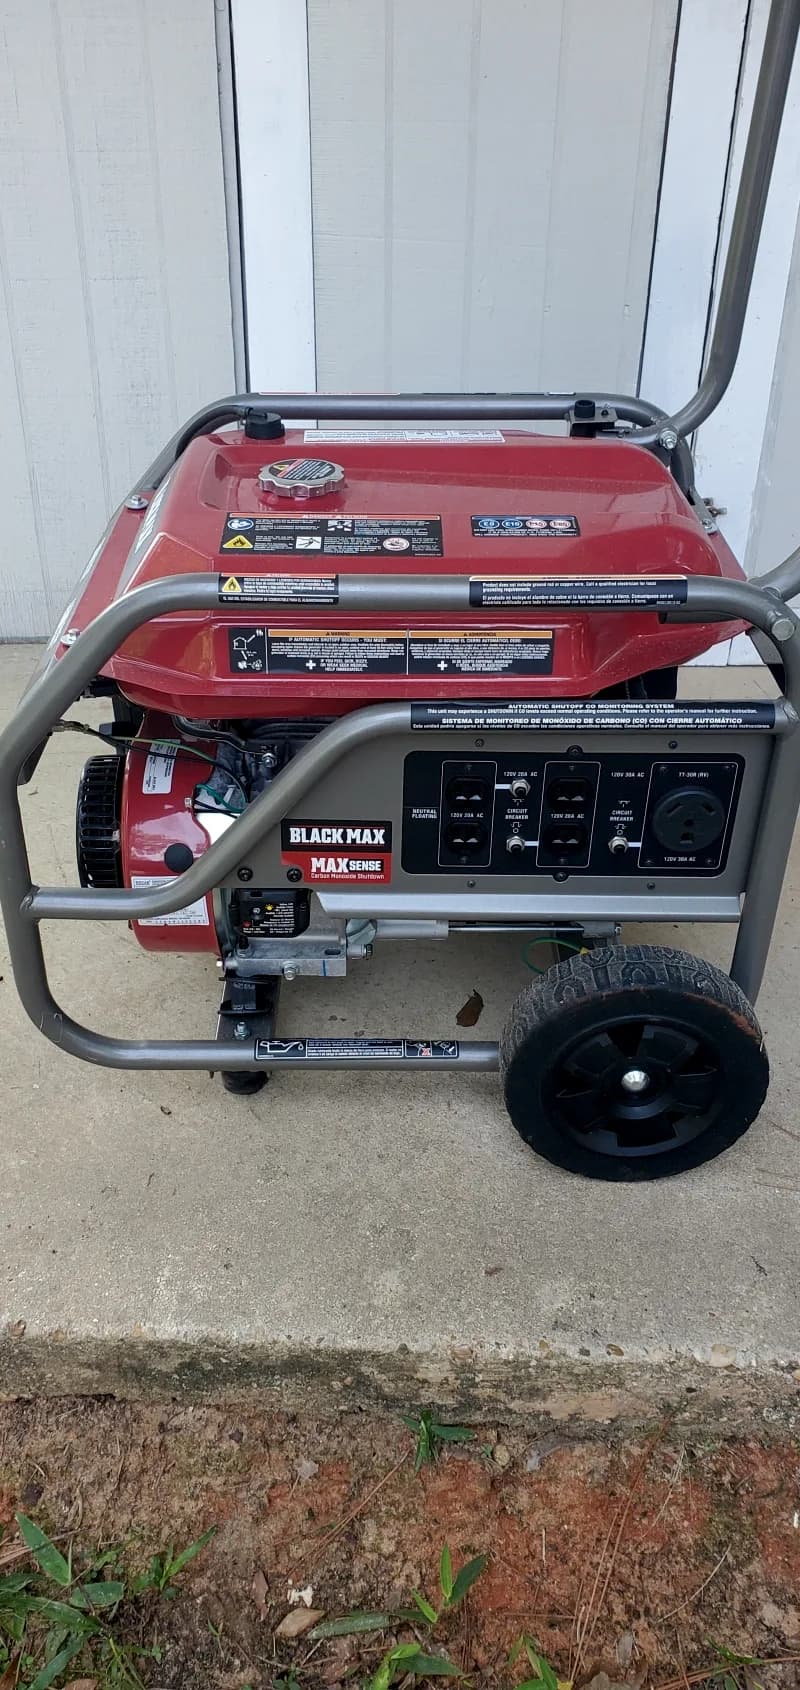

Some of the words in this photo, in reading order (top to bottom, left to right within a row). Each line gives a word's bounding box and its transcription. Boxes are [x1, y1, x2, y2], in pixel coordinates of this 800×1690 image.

[289, 828, 344, 844] BLACK
[346, 828, 385, 844] MAX
[311, 858, 349, 873] MAX
[349, 861, 381, 871] SENSE
